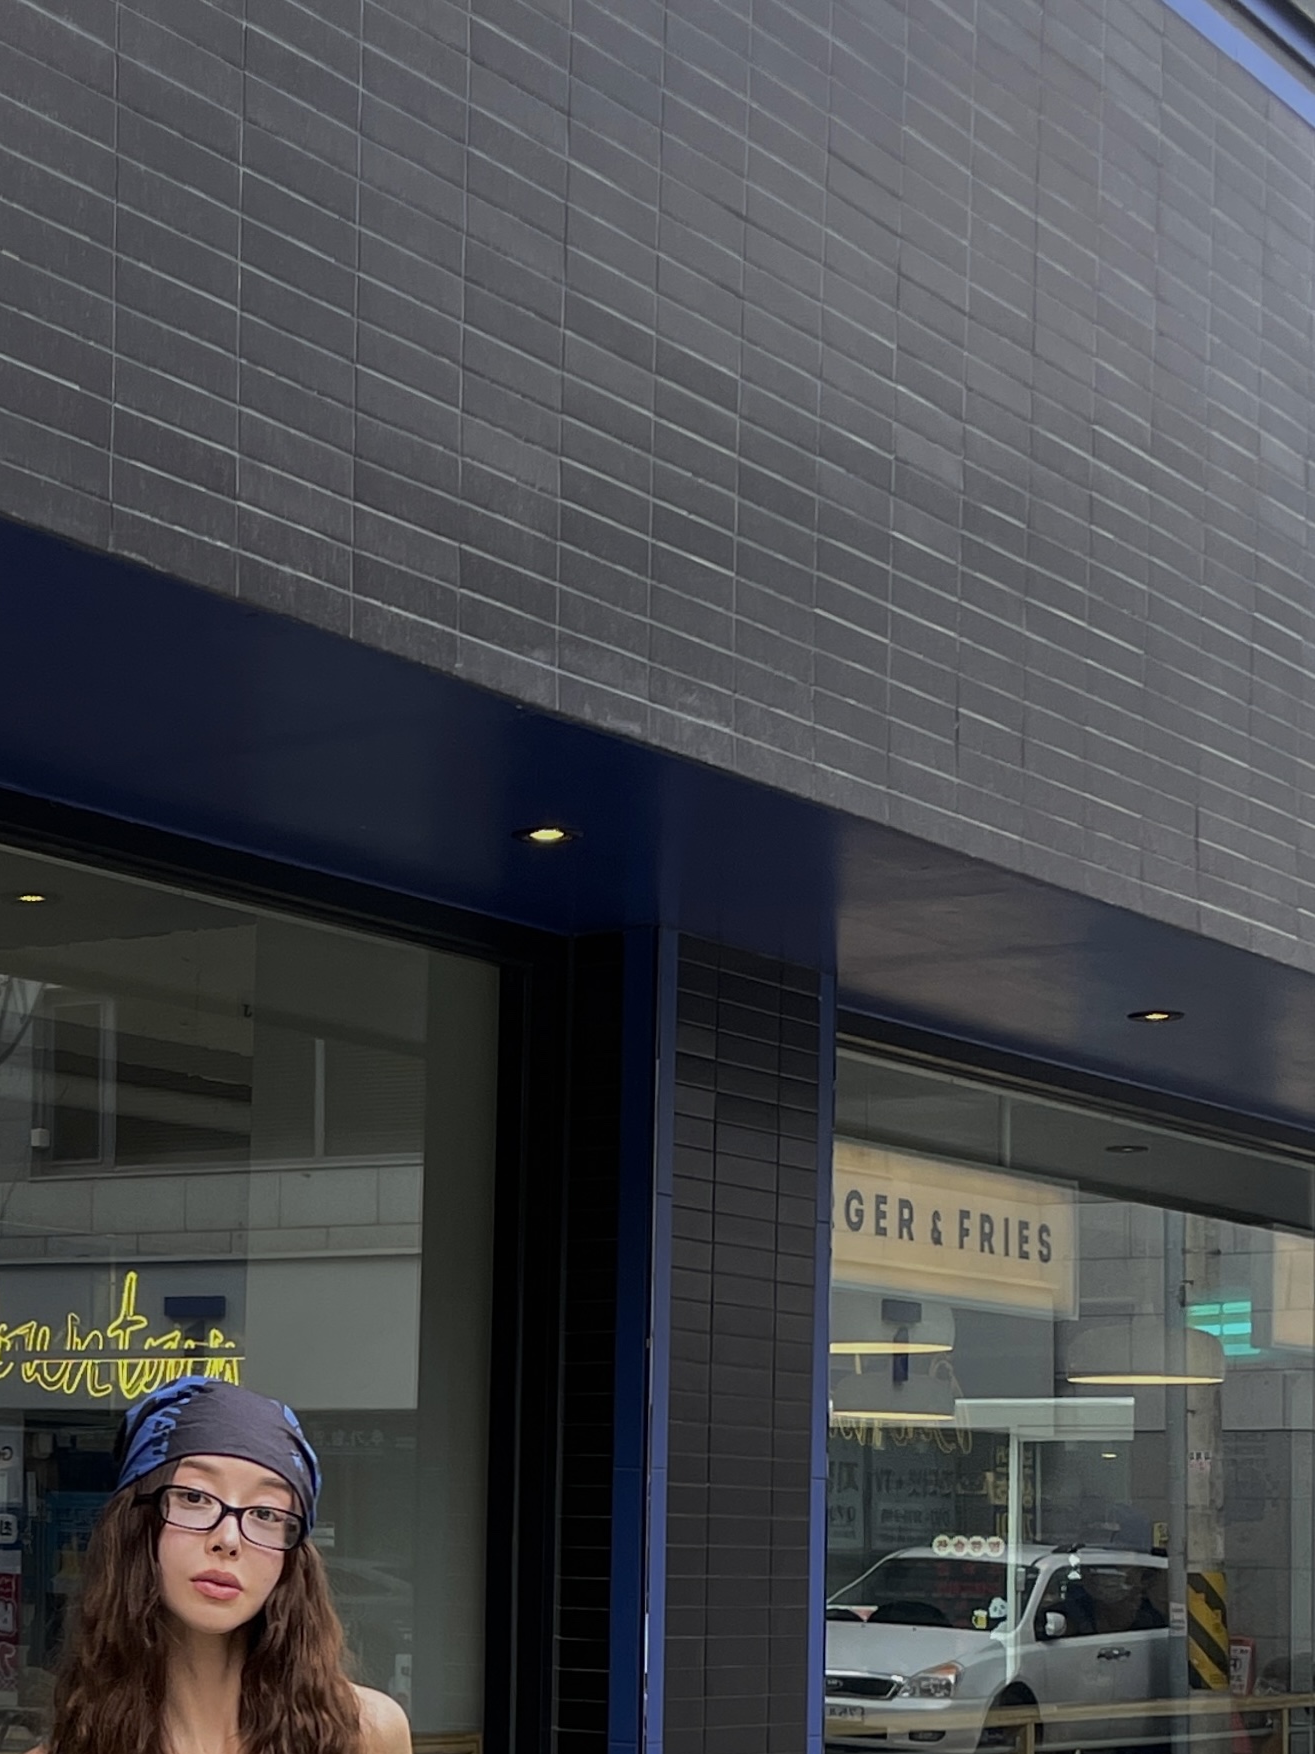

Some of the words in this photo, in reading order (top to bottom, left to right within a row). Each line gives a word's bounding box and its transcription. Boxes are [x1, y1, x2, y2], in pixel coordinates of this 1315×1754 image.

[831, 1188, 915, 1242] GER
[929, 1209, 944, 1246] &
[957, 1209, 1053, 1264] FRIES
